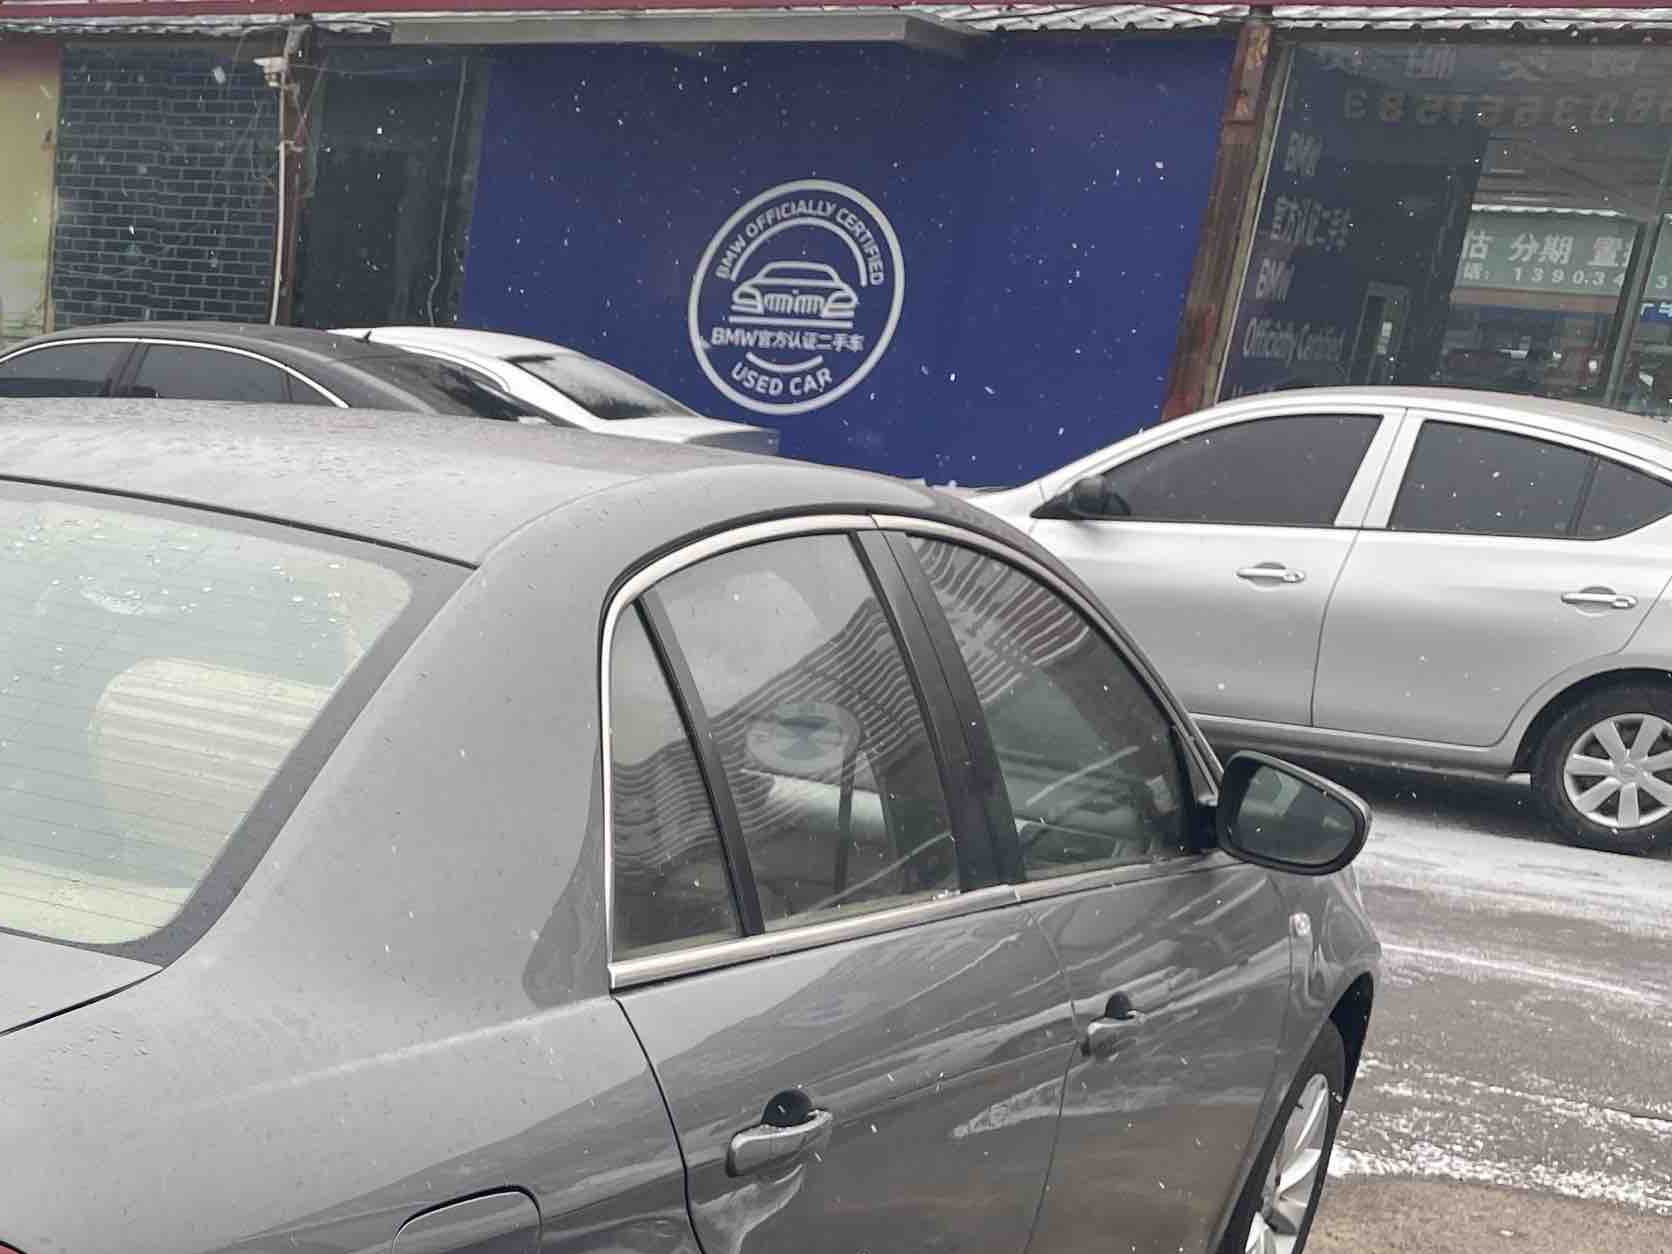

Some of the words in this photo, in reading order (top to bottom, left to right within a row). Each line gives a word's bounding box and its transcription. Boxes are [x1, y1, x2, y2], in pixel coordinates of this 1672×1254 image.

[715, 234, 746, 279] BMW
[745, 199, 837, 239] OFFICIALLY
[835, 208, 884, 286] CERTIFIED
[1507, 232, 1575, 266] 分期
[1586, 235, 1635, 268] 置
[731, 362, 783, 396] USED
[789, 368, 833, 396] CAR
